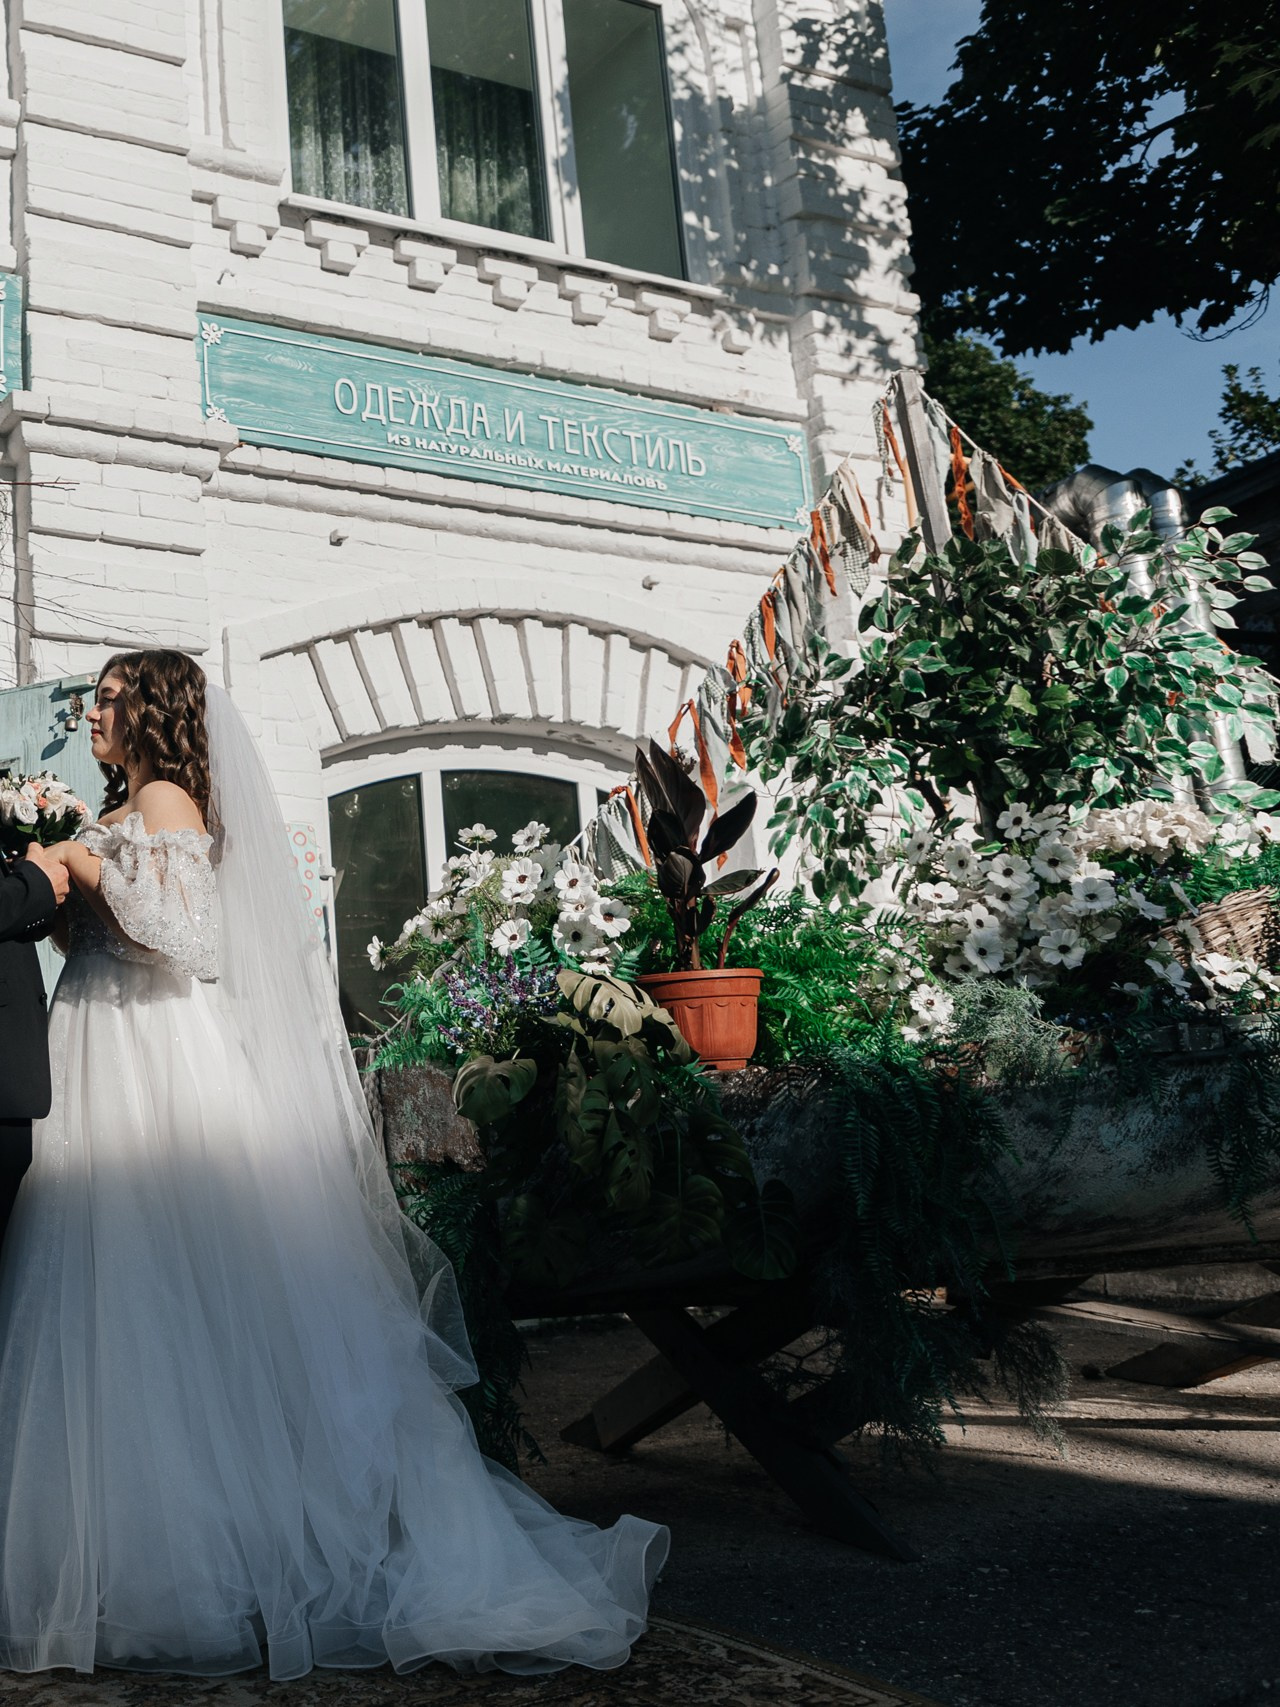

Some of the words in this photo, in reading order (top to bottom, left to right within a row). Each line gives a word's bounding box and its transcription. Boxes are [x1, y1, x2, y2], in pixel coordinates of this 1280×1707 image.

[333, 377, 491, 441] ОДЕЖДА
[505, 409, 526, 447] И
[539, 413, 707, 478] ТЕКСТИЛЬ
[386, 431, 412, 447] ИЗ
[415, 436, 544, 470] НАТУРАЛЬНЫХ
[547, 460, 668, 492] МАТЕРИАЛОВЪ
